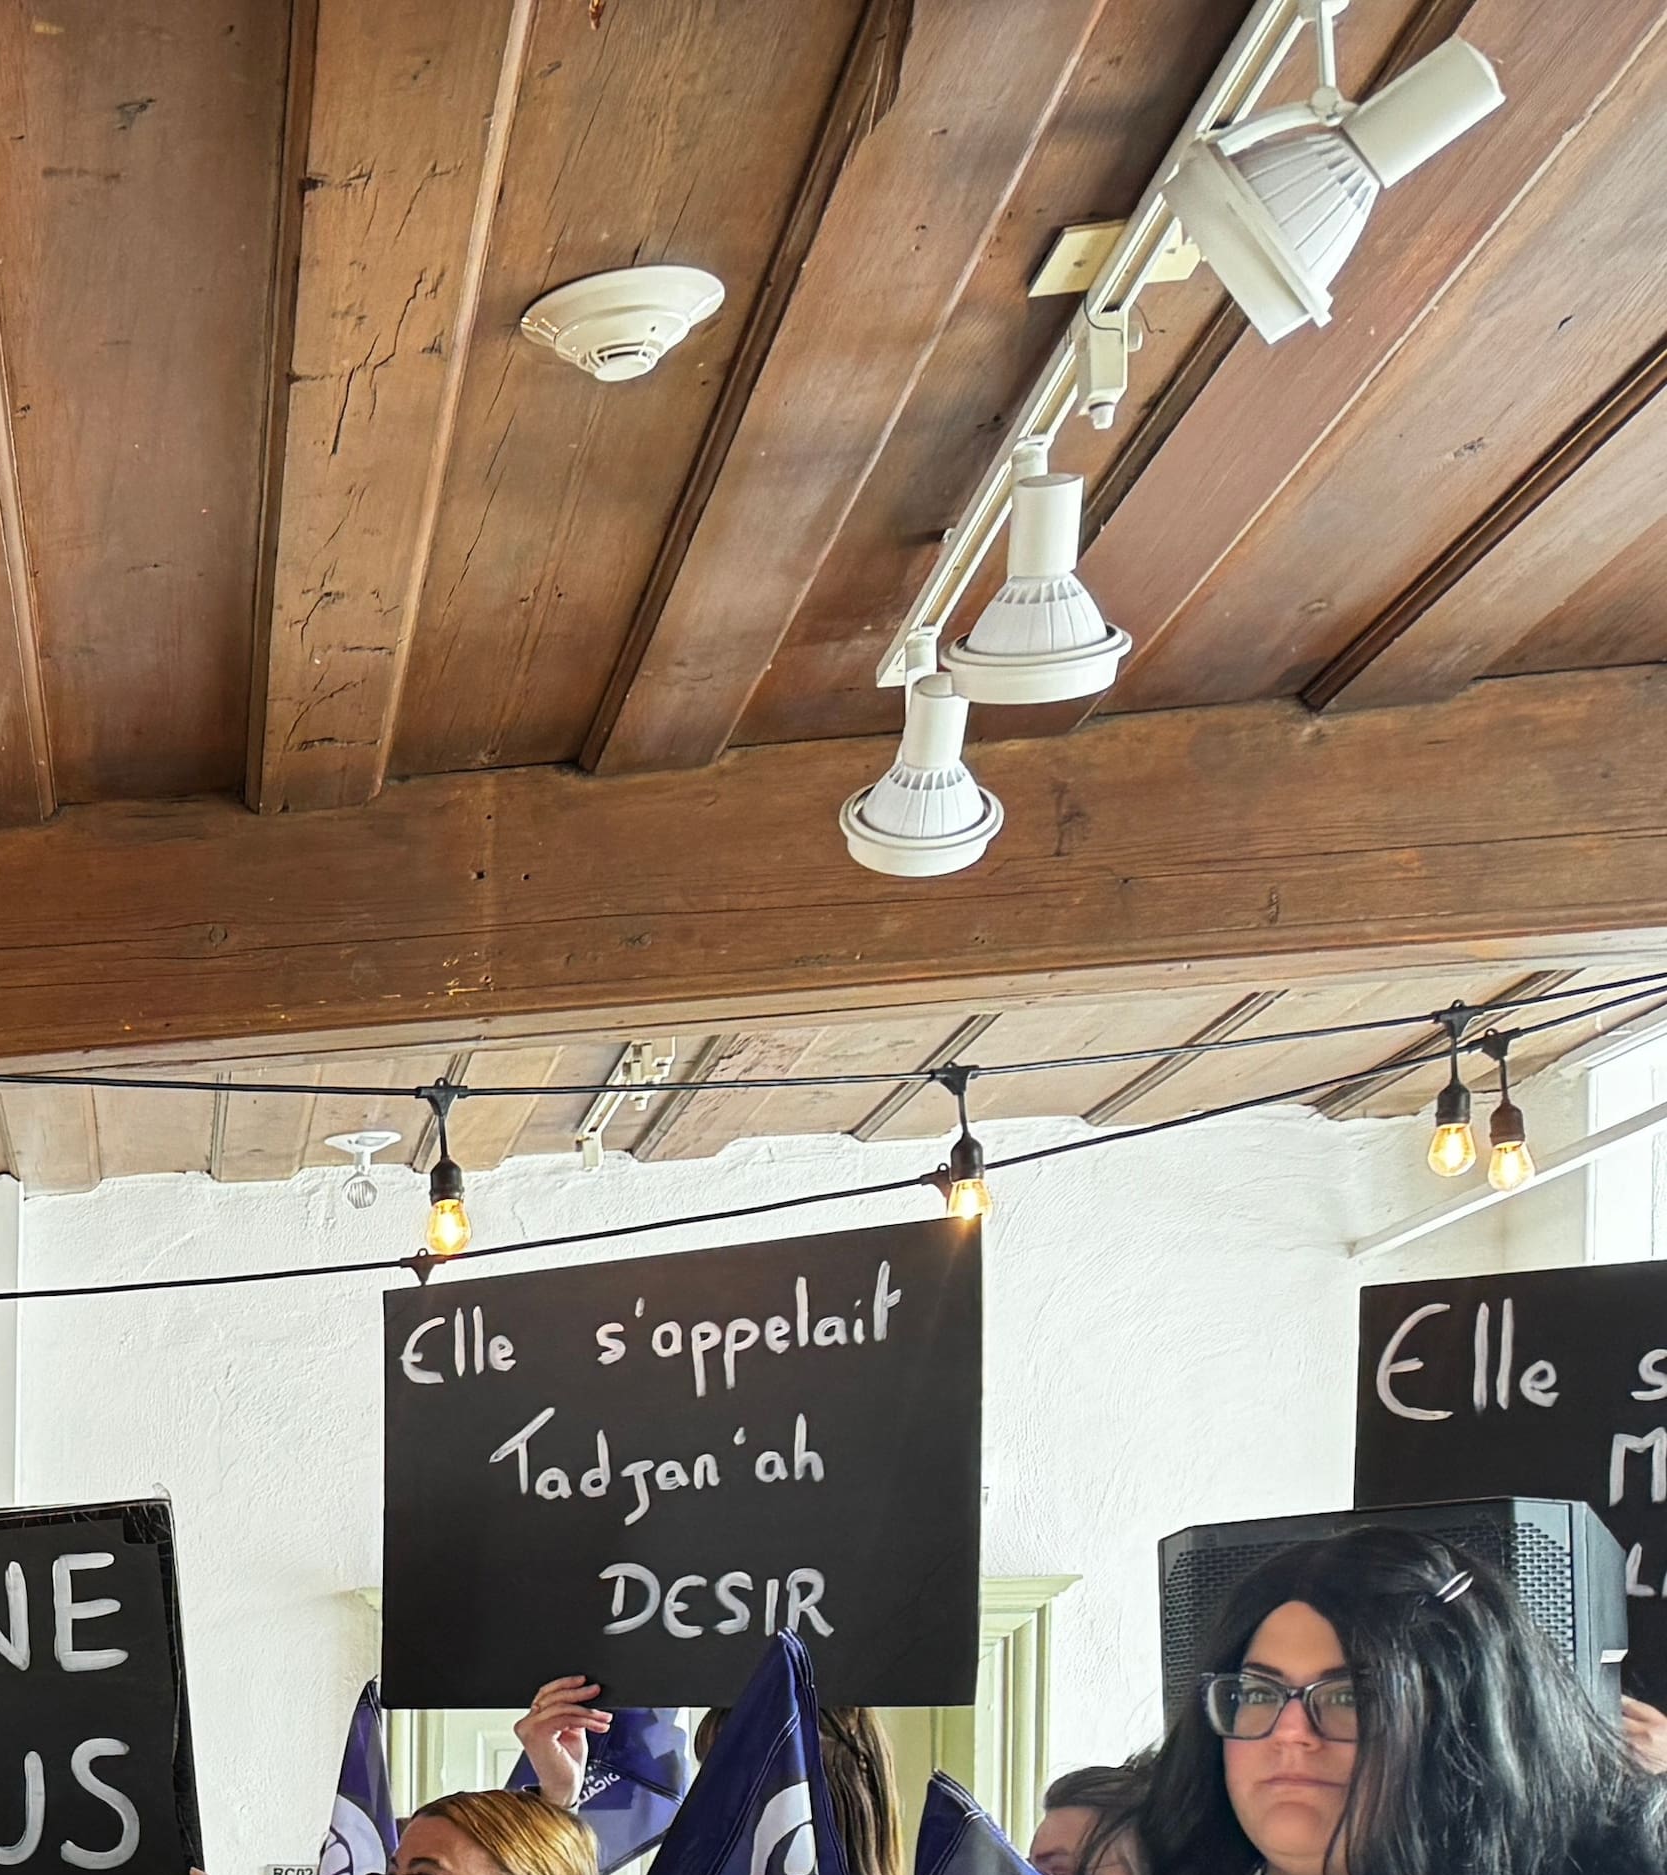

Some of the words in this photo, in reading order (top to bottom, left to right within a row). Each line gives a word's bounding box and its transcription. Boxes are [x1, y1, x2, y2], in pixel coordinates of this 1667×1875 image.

[400, 1306, 516, 1384] Elle
[596, 1260, 902, 1397] s'appelait
[1376, 1297, 1560, 1421] Elle
[598, 1562, 835, 1638] DESIR
